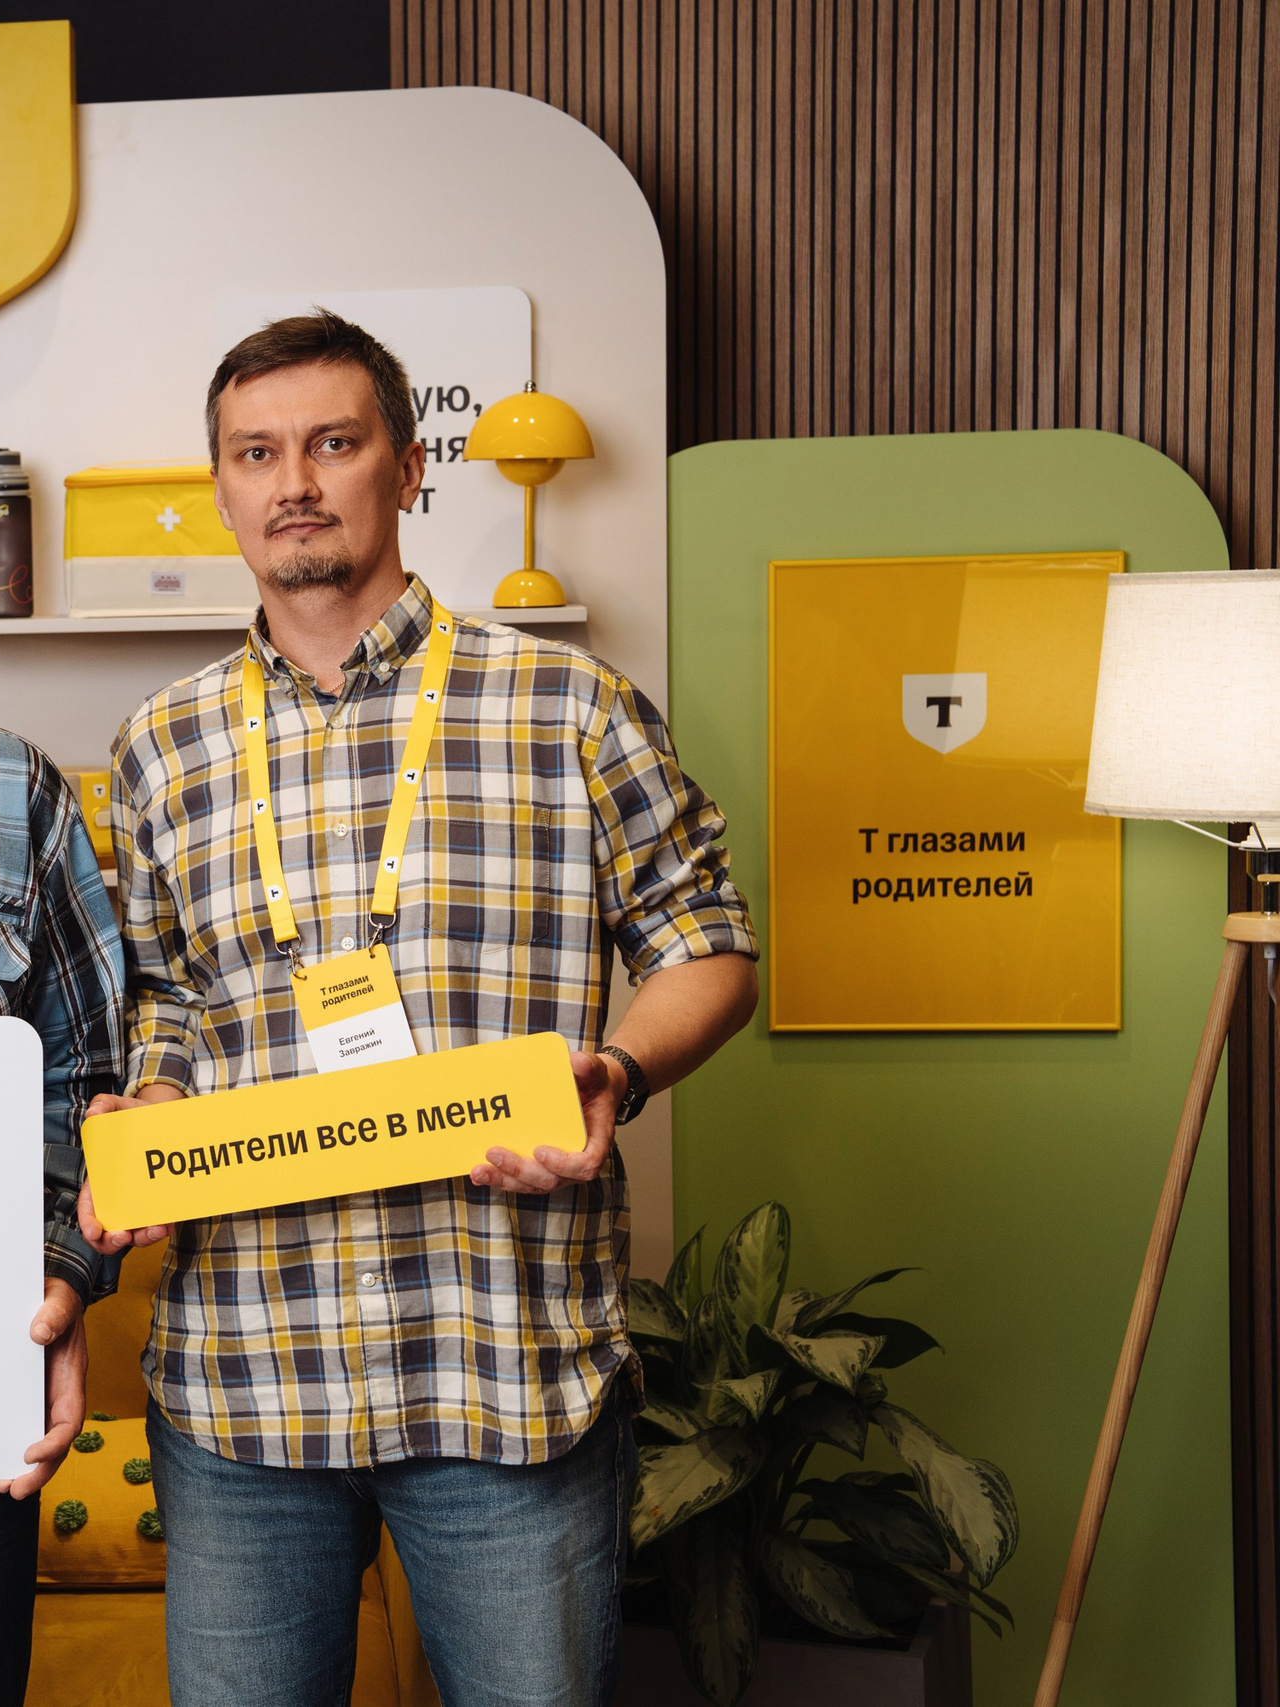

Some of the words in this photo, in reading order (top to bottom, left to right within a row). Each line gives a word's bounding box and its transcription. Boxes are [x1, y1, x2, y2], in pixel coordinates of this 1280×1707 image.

[926, 696, 962, 728] Т
[858, 828, 879, 854] Т
[887, 828, 1026, 854] глазами
[852, 871, 1033, 905] родителей
[320, 987, 327, 996] Т
[328, 975, 370, 994] глазами
[322, 984, 375, 1010] родителей
[338, 1028, 376, 1046] Евгений
[338, 1038, 383, 1059] Завражин
[144, 1129, 309, 1180] Родители
[316, 1117, 378, 1151] все
[386, 1112, 408, 1139] в
[416, 1093, 512, 1134] меня
